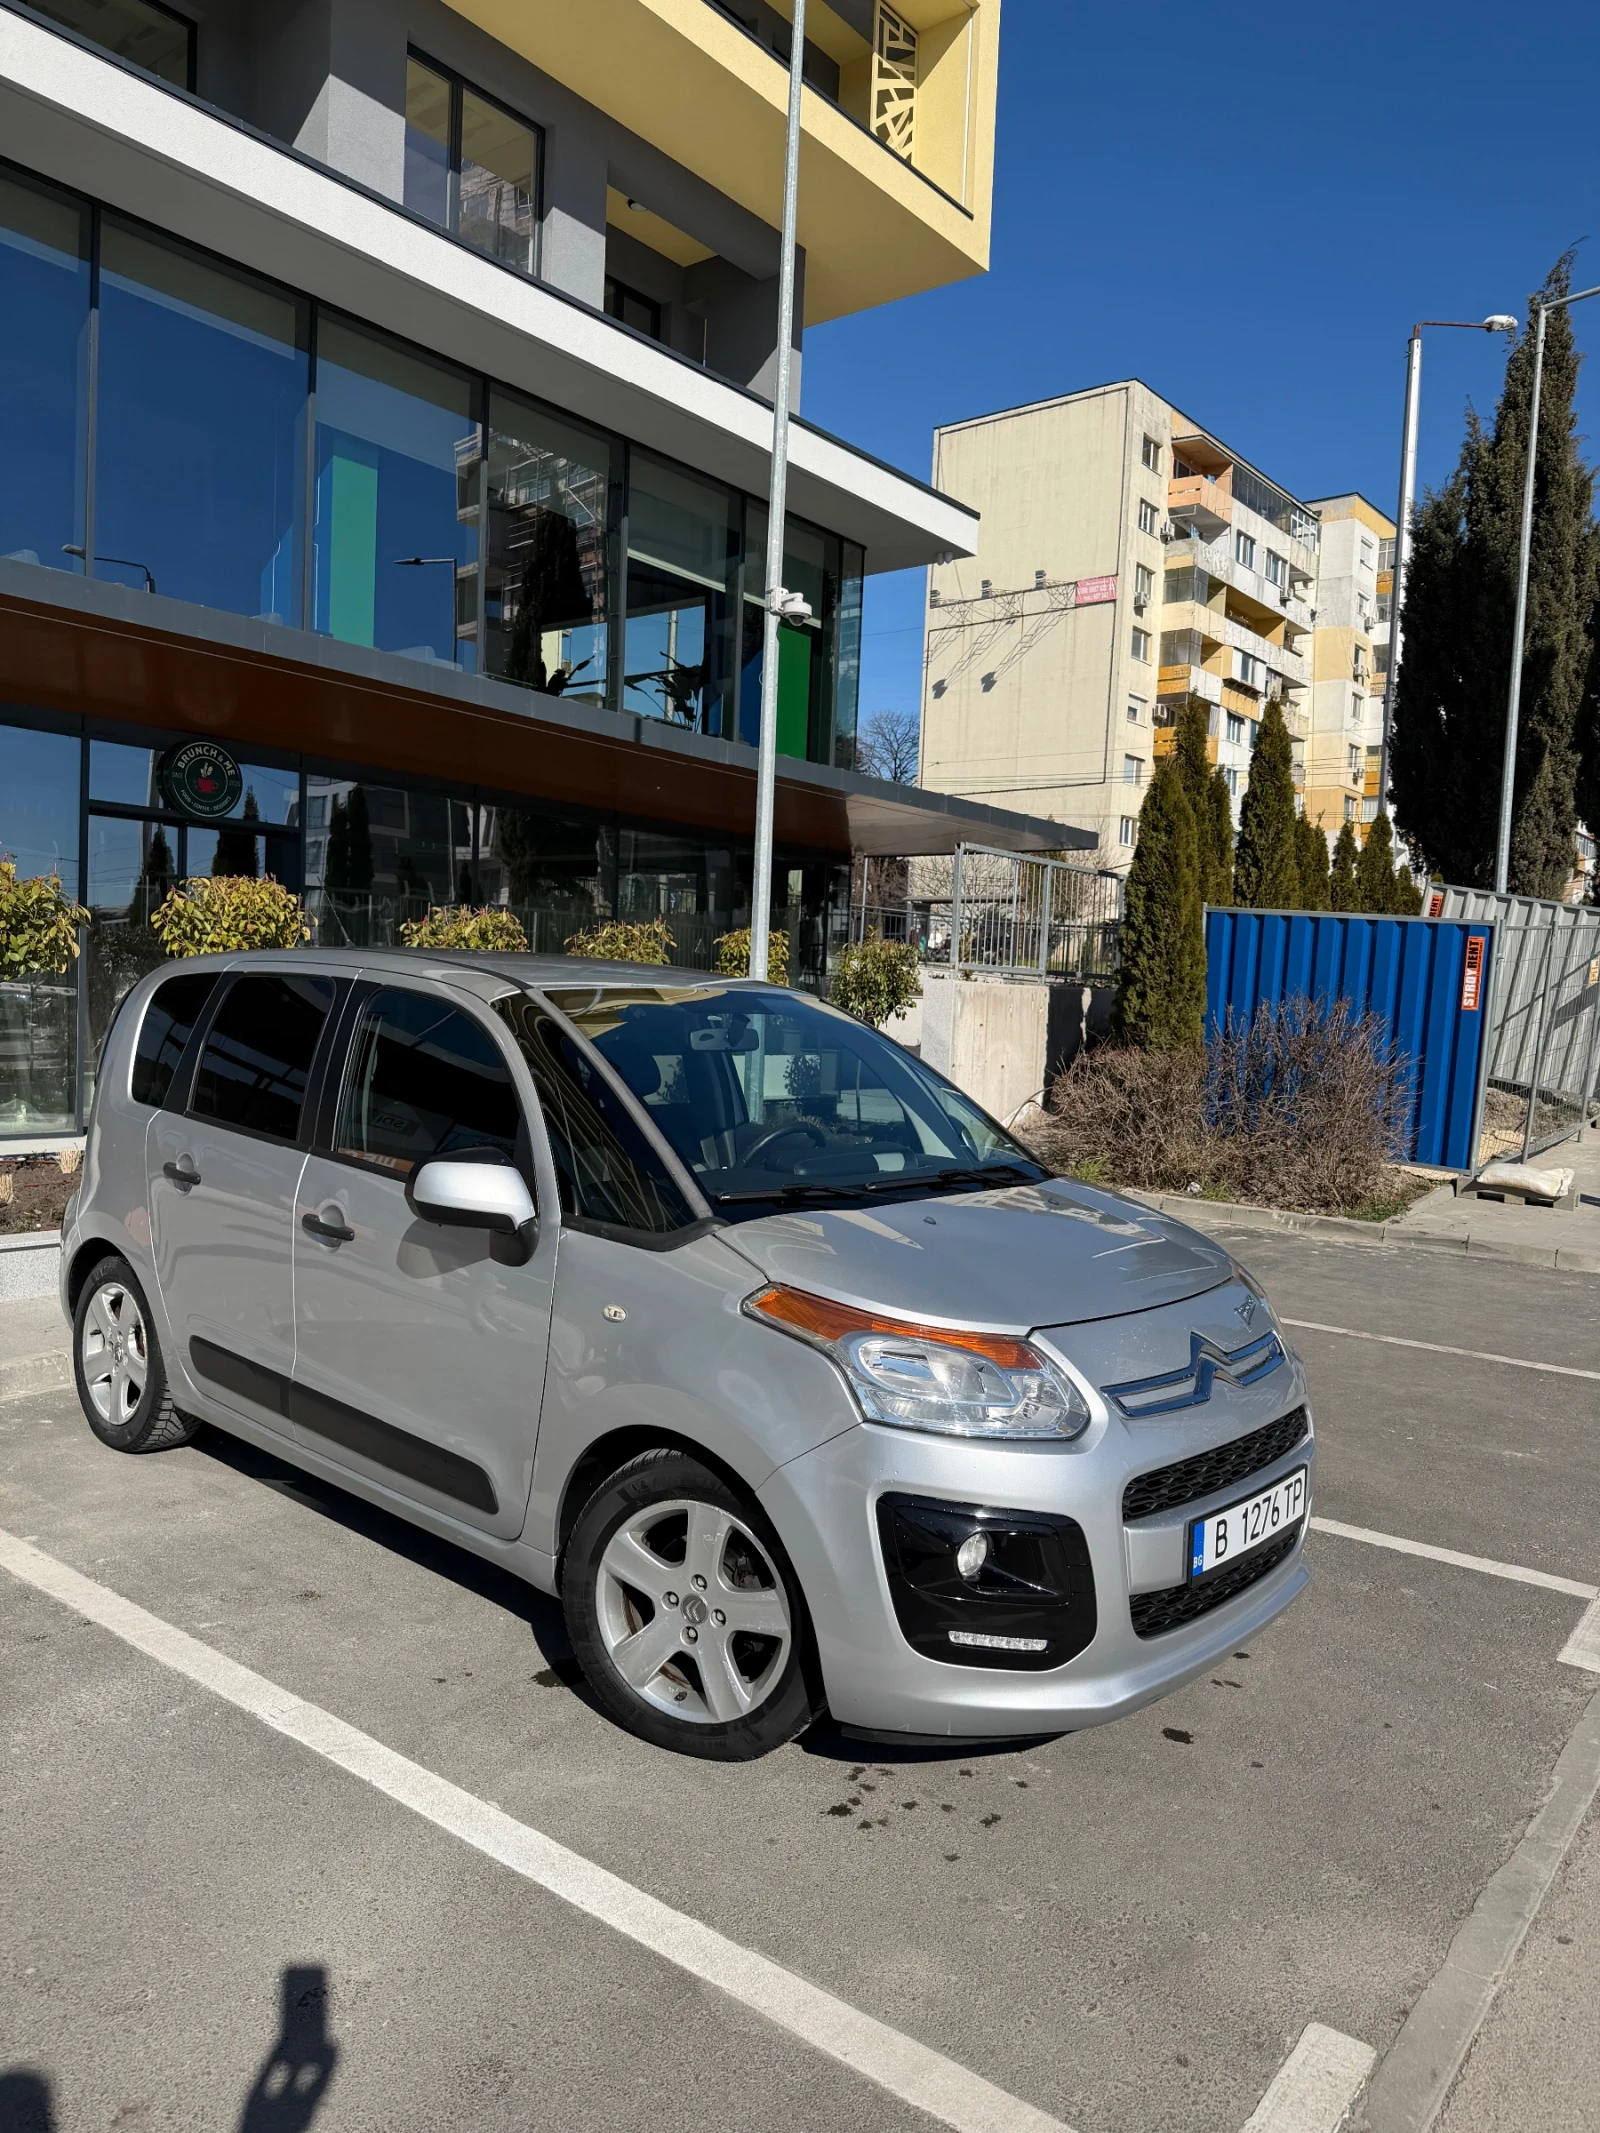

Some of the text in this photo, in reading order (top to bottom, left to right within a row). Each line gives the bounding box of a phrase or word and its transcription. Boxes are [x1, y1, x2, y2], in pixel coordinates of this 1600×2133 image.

[177, 746, 236, 776] BRUNCH & ME
[1215, 1477, 1303, 1560] B 1276 TP
[1193, 1554, 1203, 1569] BG
